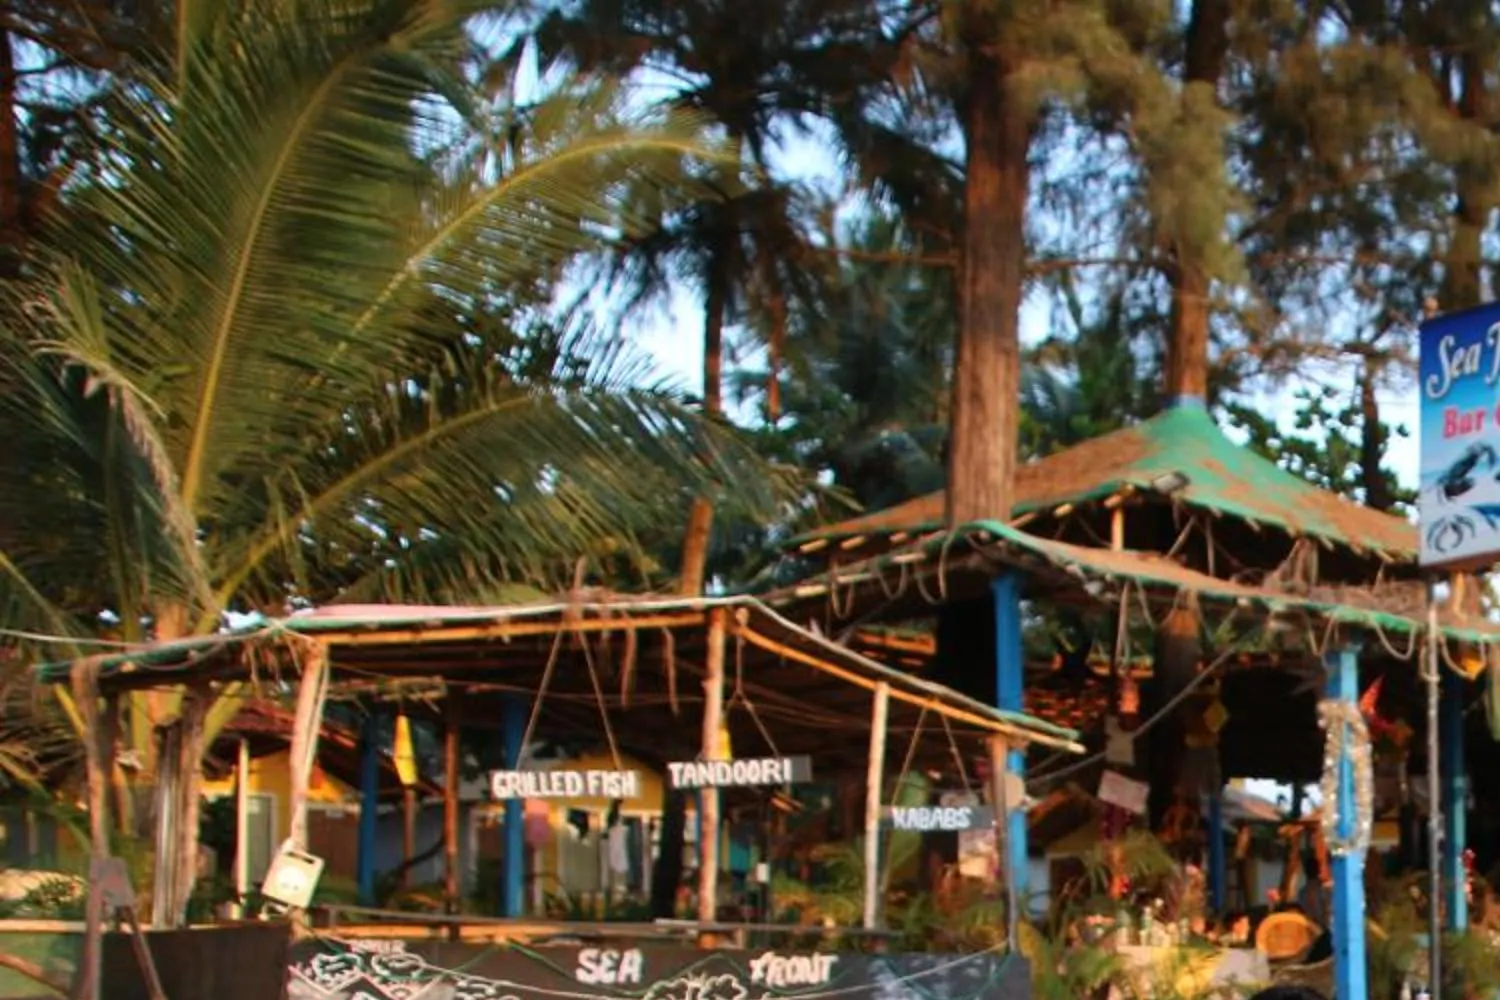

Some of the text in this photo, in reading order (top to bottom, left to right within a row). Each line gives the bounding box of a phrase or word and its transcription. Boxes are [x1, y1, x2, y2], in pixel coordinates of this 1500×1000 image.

[1426, 335, 1480, 398] Sea
[1442, 406, 1486, 440] Bar
[492, 769, 637, 799] GRILLED FISH
[667, 757, 792, 788] TANDOORI
[575, 948, 643, 984] SEA
